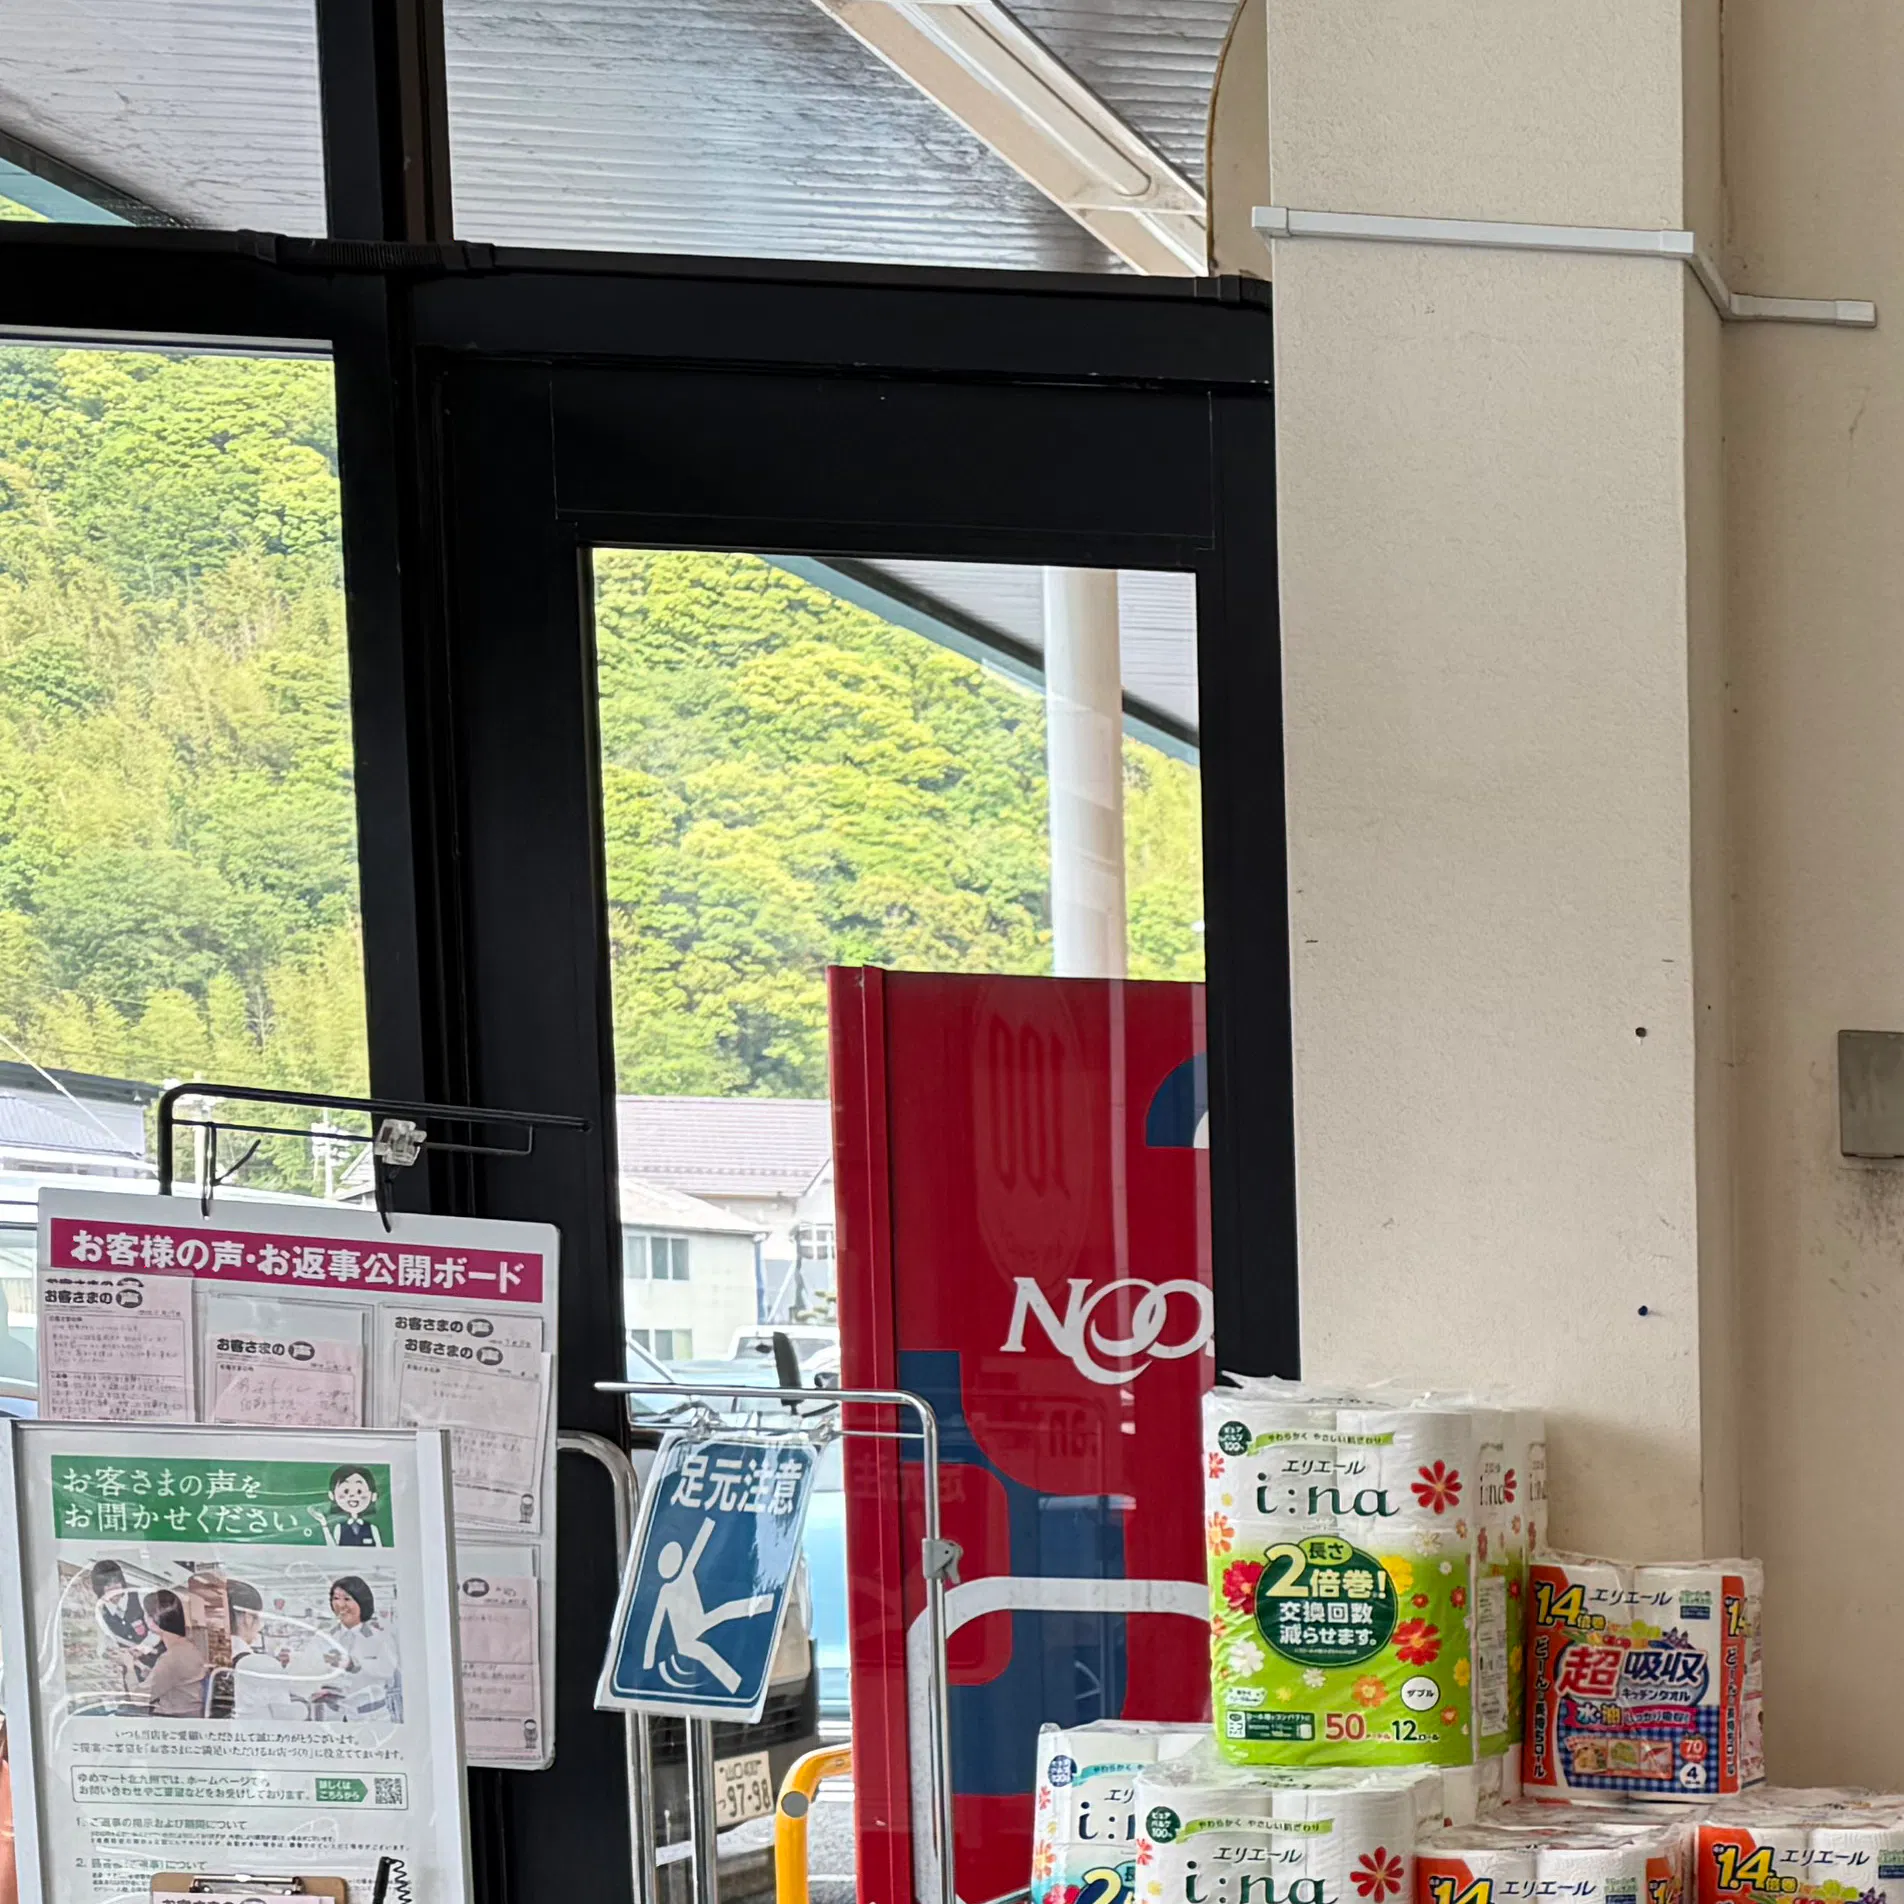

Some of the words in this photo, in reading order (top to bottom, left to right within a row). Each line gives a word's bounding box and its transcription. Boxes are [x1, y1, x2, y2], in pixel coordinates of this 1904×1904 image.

[71, 1230, 525, 1293] お客様の声・お返事公開ボード
[1281, 1459, 1366, 1475] エリエール
[63, 1466, 262, 1500] お客さまの声を
[671, 1456, 803, 1515] 足元注意
[65, 1505, 313, 1538] お聞かせください。
[1588, 1588, 1672, 1606] エリエール
[1279, 1602, 1373, 1625] 交換回数
[1279, 1627, 1376, 1646] 減らせます。
[1213, 1847, 1302, 1863] エリエール
[1780, 1846, 1870, 1868] エリエール
[1499, 1880, 1596, 1898] エリエール
